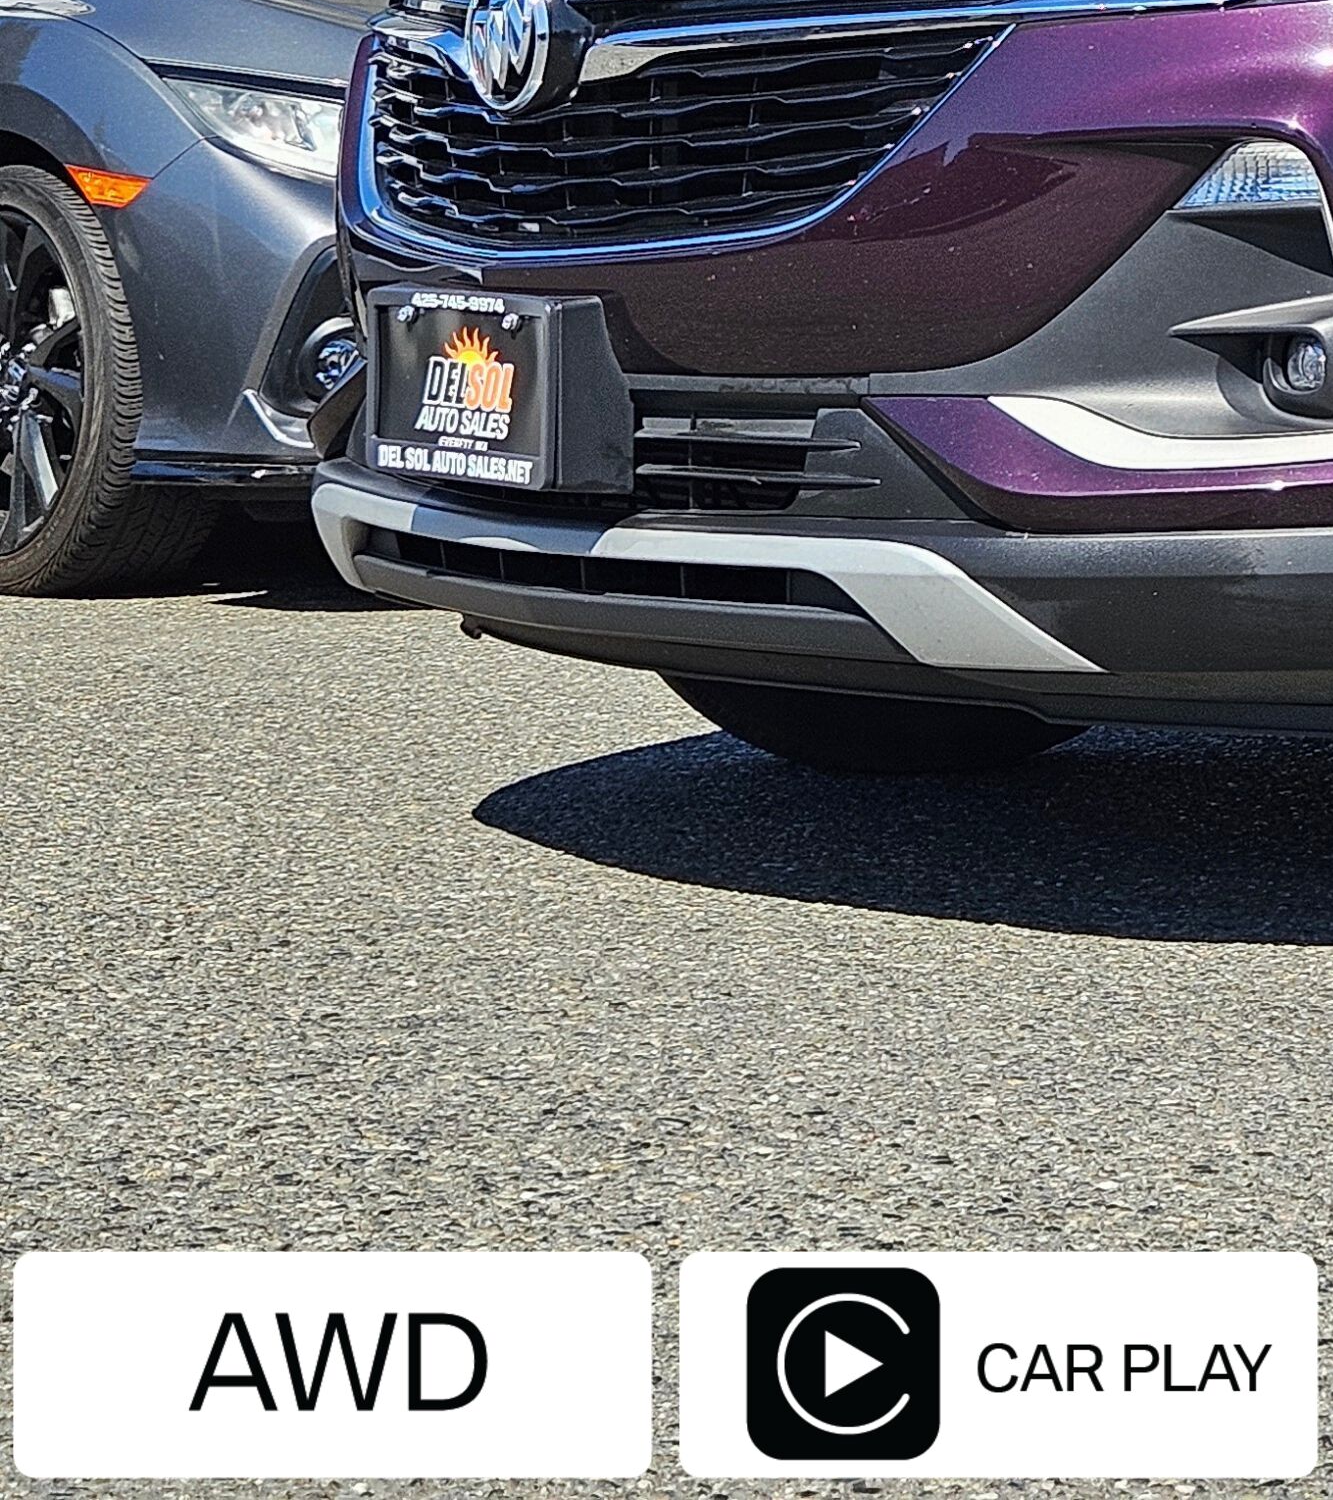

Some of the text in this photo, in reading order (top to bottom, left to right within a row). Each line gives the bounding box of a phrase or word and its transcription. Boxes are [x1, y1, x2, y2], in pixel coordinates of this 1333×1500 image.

[415, 406, 511, 441] AUTO SALES
[377, 444, 534, 485] DEL SOL AUTO SALES.NET
